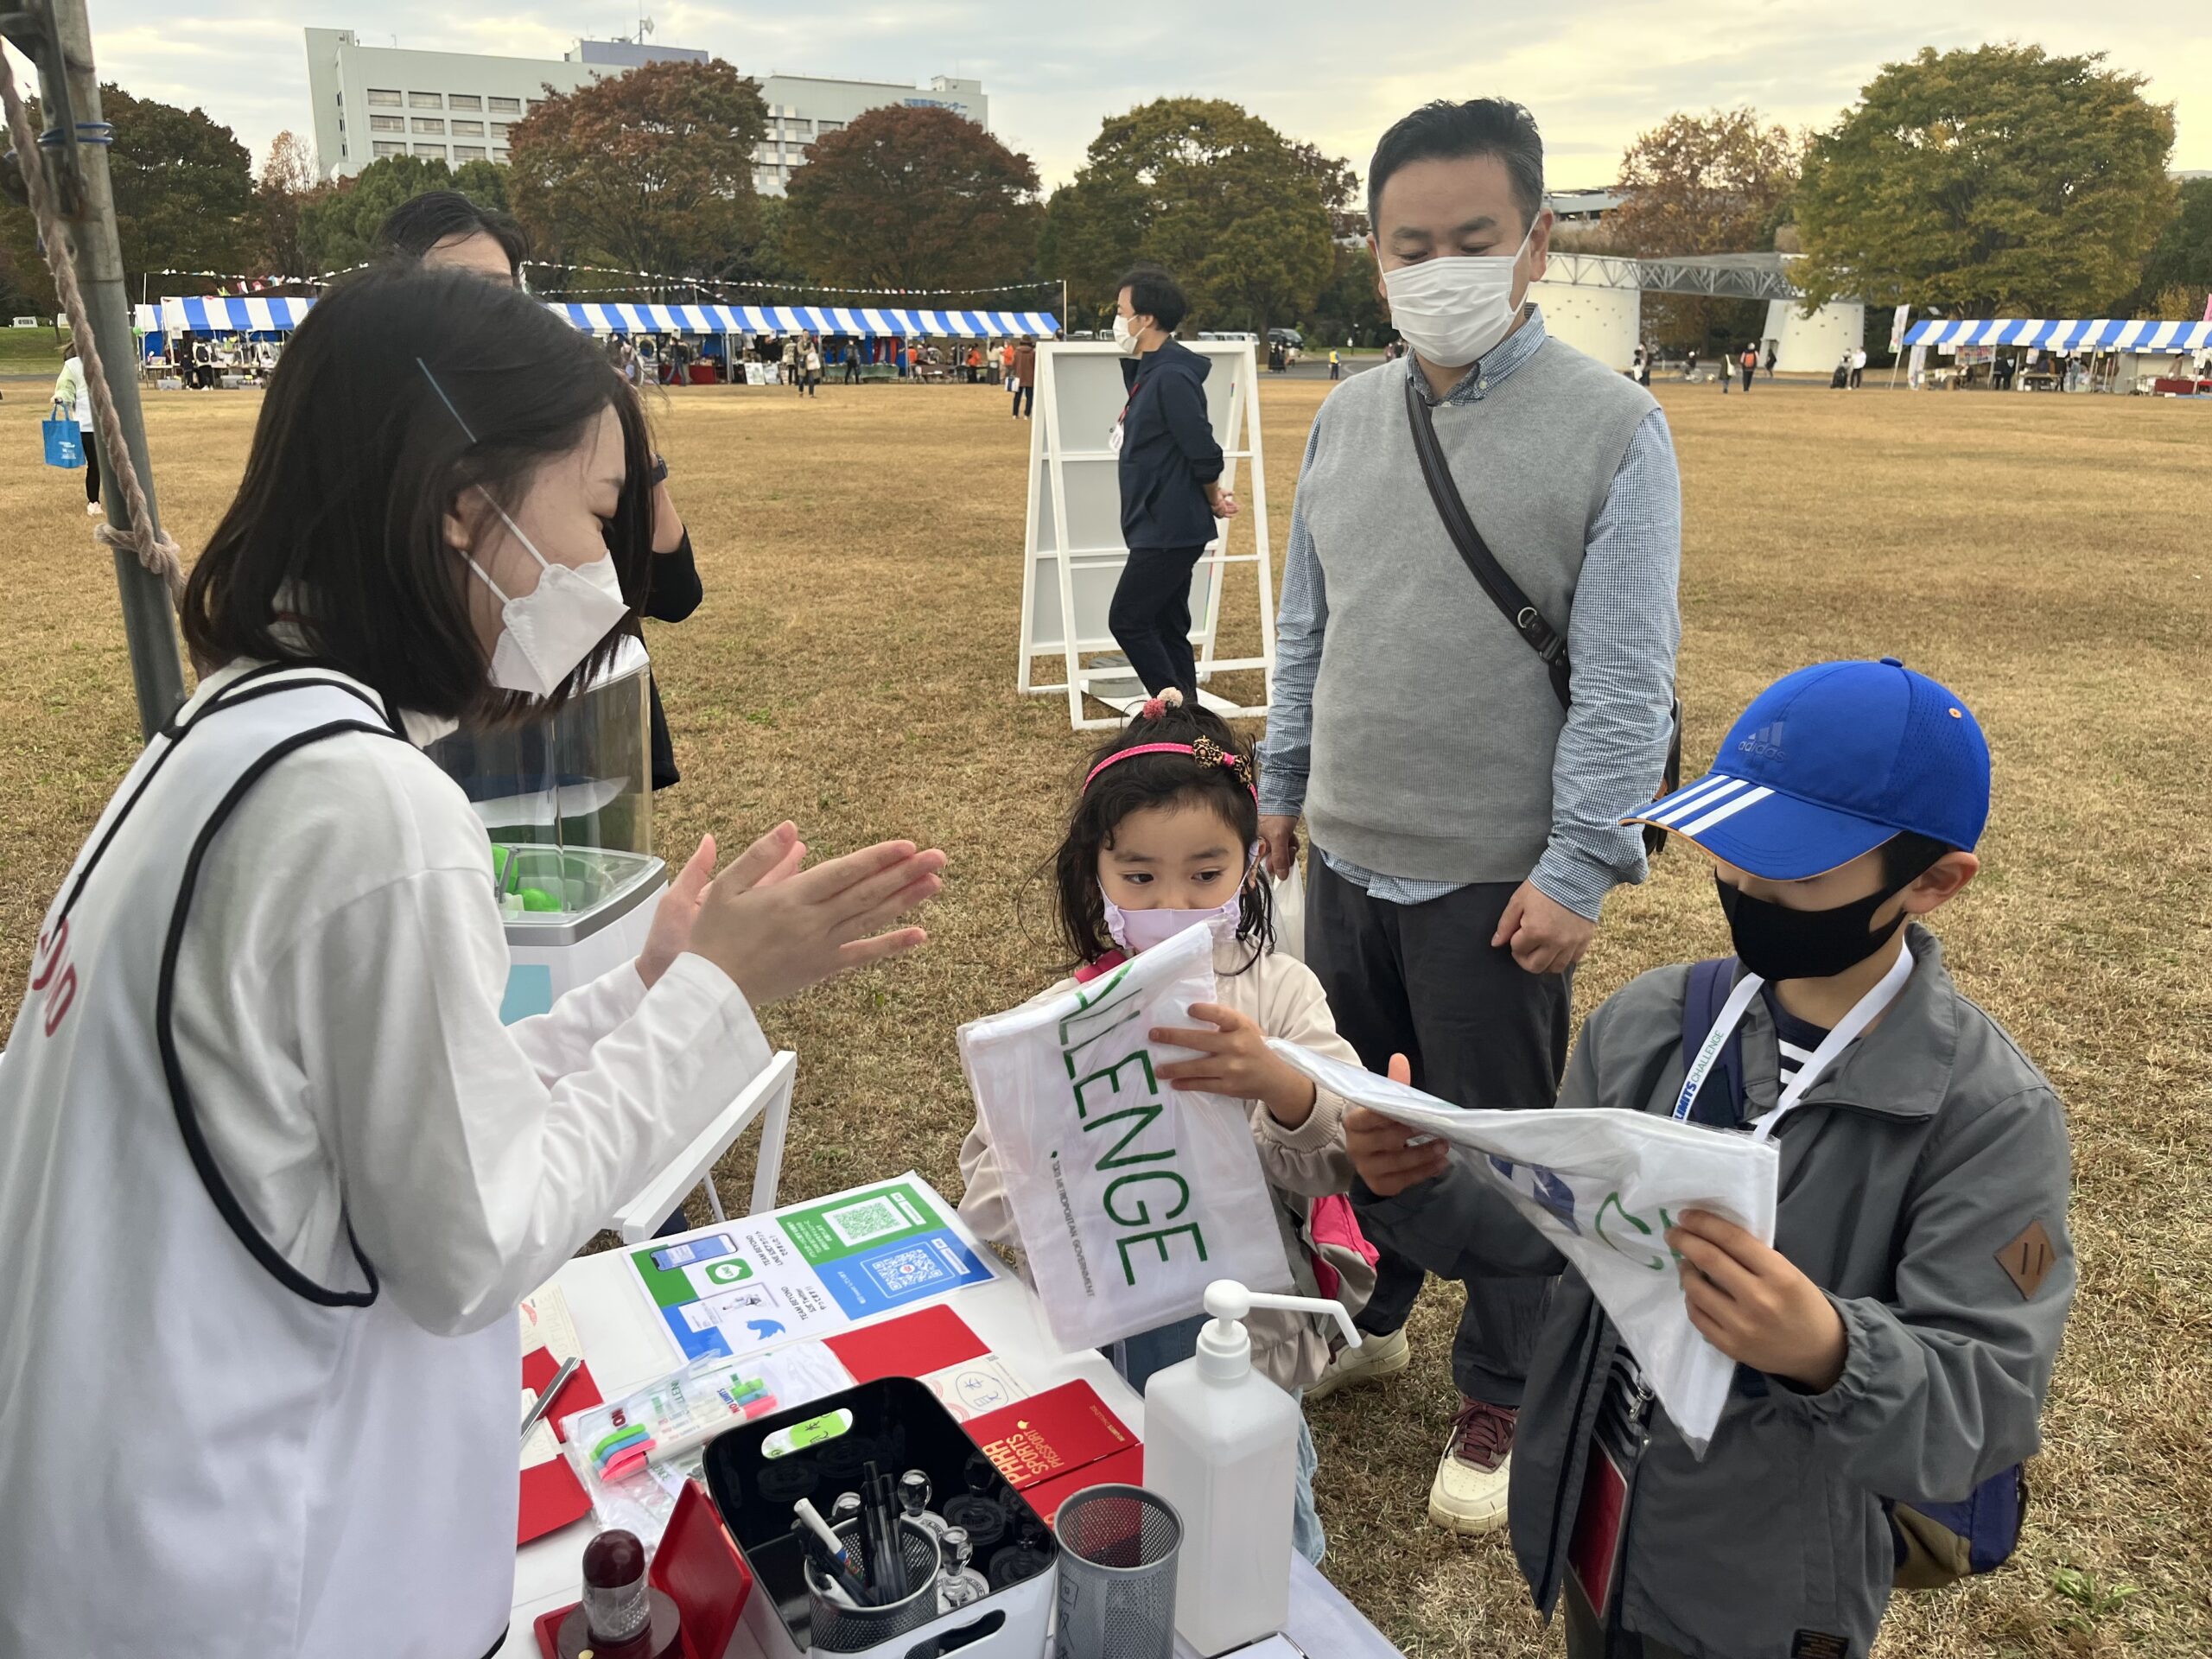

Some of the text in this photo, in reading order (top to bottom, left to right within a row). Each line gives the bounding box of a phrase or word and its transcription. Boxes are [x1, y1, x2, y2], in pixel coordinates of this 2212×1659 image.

[1738, 741, 1786, 763] adidas
[1675, 1030, 1725, 1120] LIMITS CHALLENGE
[1056, 1175, 1078, 1237] METROPOLITAN
[1073, 1239, 1095, 1297] GOVERNMENT
[781, 1286, 808, 1320] TEAM BEYOND
[717, 1388, 740, 1414] NO LIMITS
[983, 1440, 1032, 1484] PARA
[1006, 1433, 1050, 1475] SPORTS
[1023, 1429, 1065, 1468] PASSPORT
